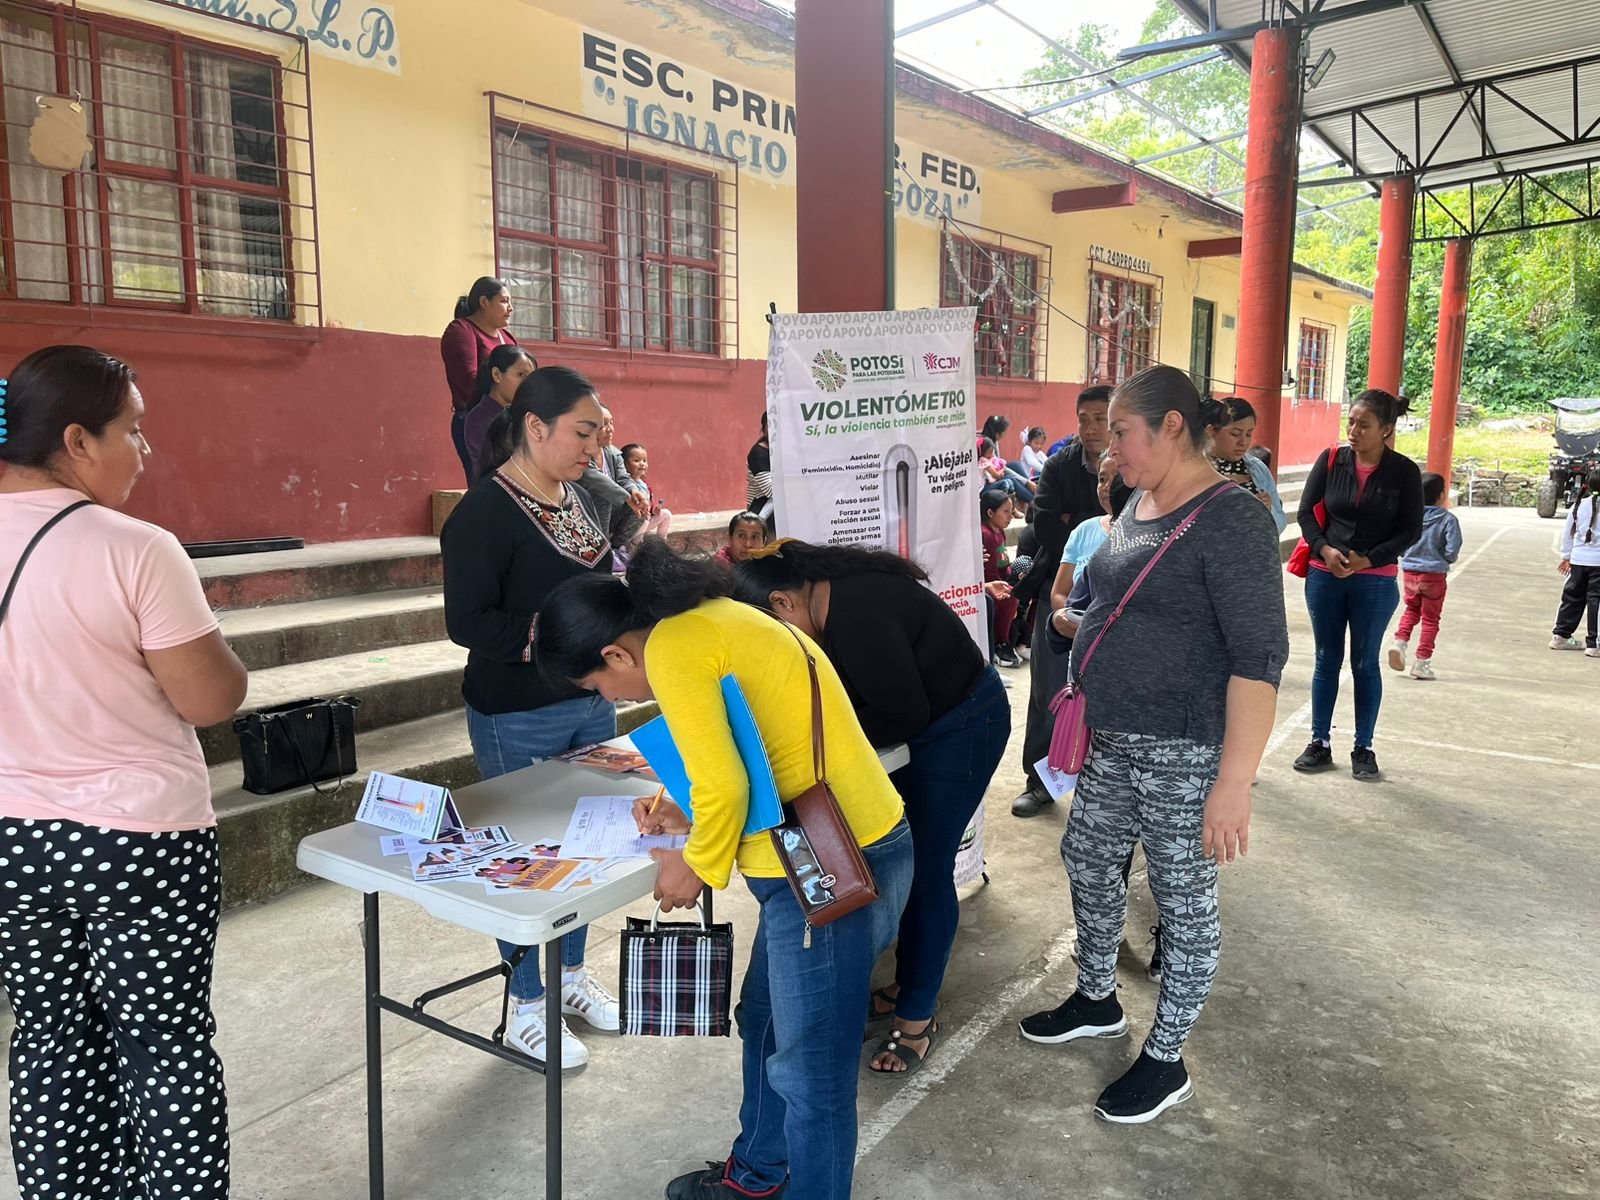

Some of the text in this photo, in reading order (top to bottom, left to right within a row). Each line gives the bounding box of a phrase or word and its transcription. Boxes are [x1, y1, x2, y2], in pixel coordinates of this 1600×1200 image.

[583, 32, 694, 103] ESC.
[921, 151, 981, 195] FED.
[938, 357, 960, 369] CJM
[800, 389, 965, 421] VIOLENTÓMETRO
[805, 424, 821, 438] Sí,
[825, 423, 837, 435] la
[841, 418, 890, 433] violencia
[893, 414, 936, 428] también
[937, 415, 948, 424] se
[949, 409, 966, 422] mide
[849, 452, 880, 461] Asesinar
[924, 448, 973, 474] ¡Aléjate!
[845, 461, 881, 471] Homicidio)
[855, 473, 879, 481] Mutilar
[927, 474, 938, 484] Tu
[940, 471, 955, 482] vida
[860, 484, 879, 492] Violar
[931, 485, 942, 493] en
[859, 494, 880, 503] sexual
[839, 509, 861, 517] Forzar
[830, 513, 881, 525] relación sexual
[833, 527, 867, 536] Amenazar
[827, 536, 853, 544] objetos
[860, 533, 881, 541] armas
